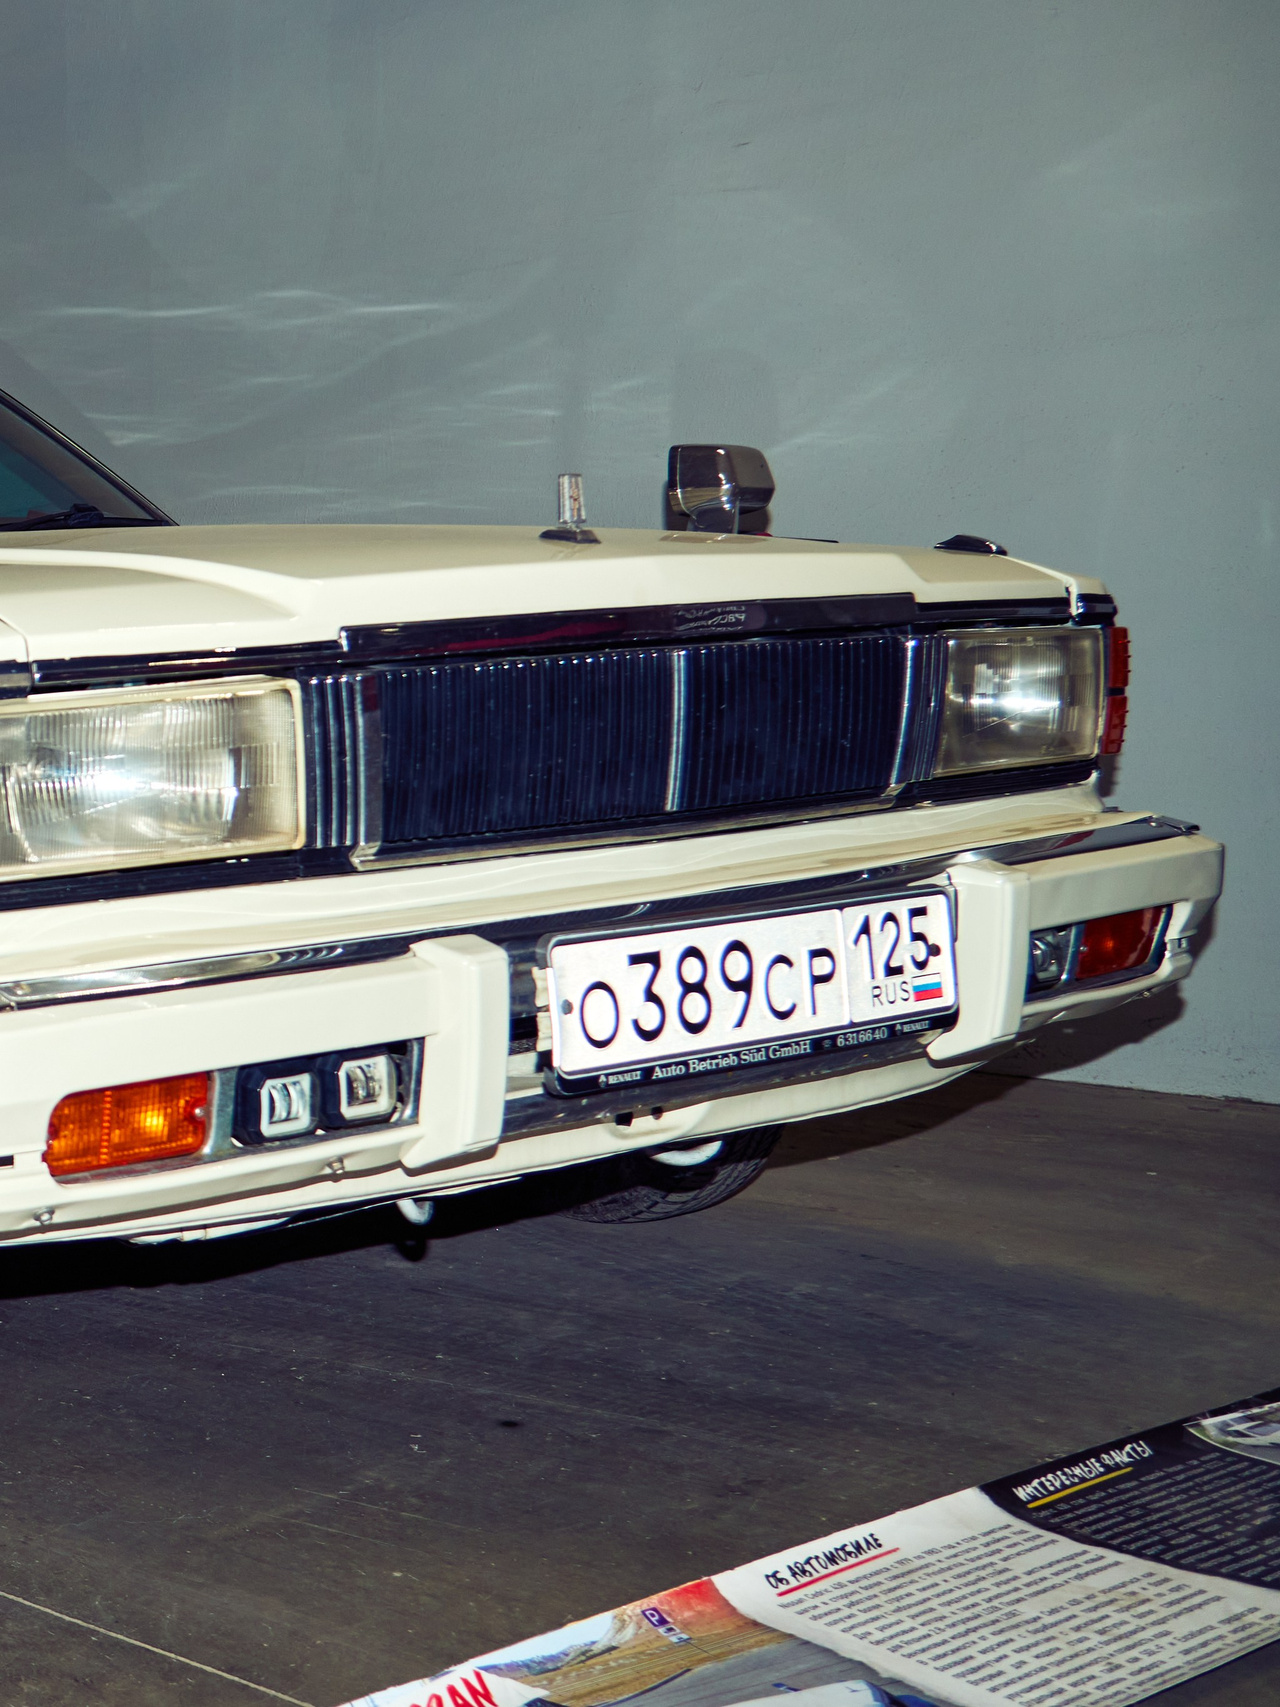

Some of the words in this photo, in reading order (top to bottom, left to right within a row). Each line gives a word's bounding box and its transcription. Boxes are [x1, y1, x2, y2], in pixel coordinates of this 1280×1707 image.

[853, 905, 930, 980] 125
[871, 980, 911, 1008] RUS
[607, 1070, 642, 1085] RENAULT
[651, 1065, 686, 1080] Auto
[687, 1053, 738, 1073] Betrieb
[740, 1047, 767, 1064] Süd
[769, 1039, 812, 1059] GmbH
[1011, 1457, 1106, 1502] ИНТЕРЕСНЫЕ
[1100, 1440, 1154, 1468] ФАКТЫ
[764, 1570, 791, 1590] ОБ
[786, 1532, 884, 1583] АВТОМОБИЛЕ
[777, 1597, 805, 1608] Nissan
